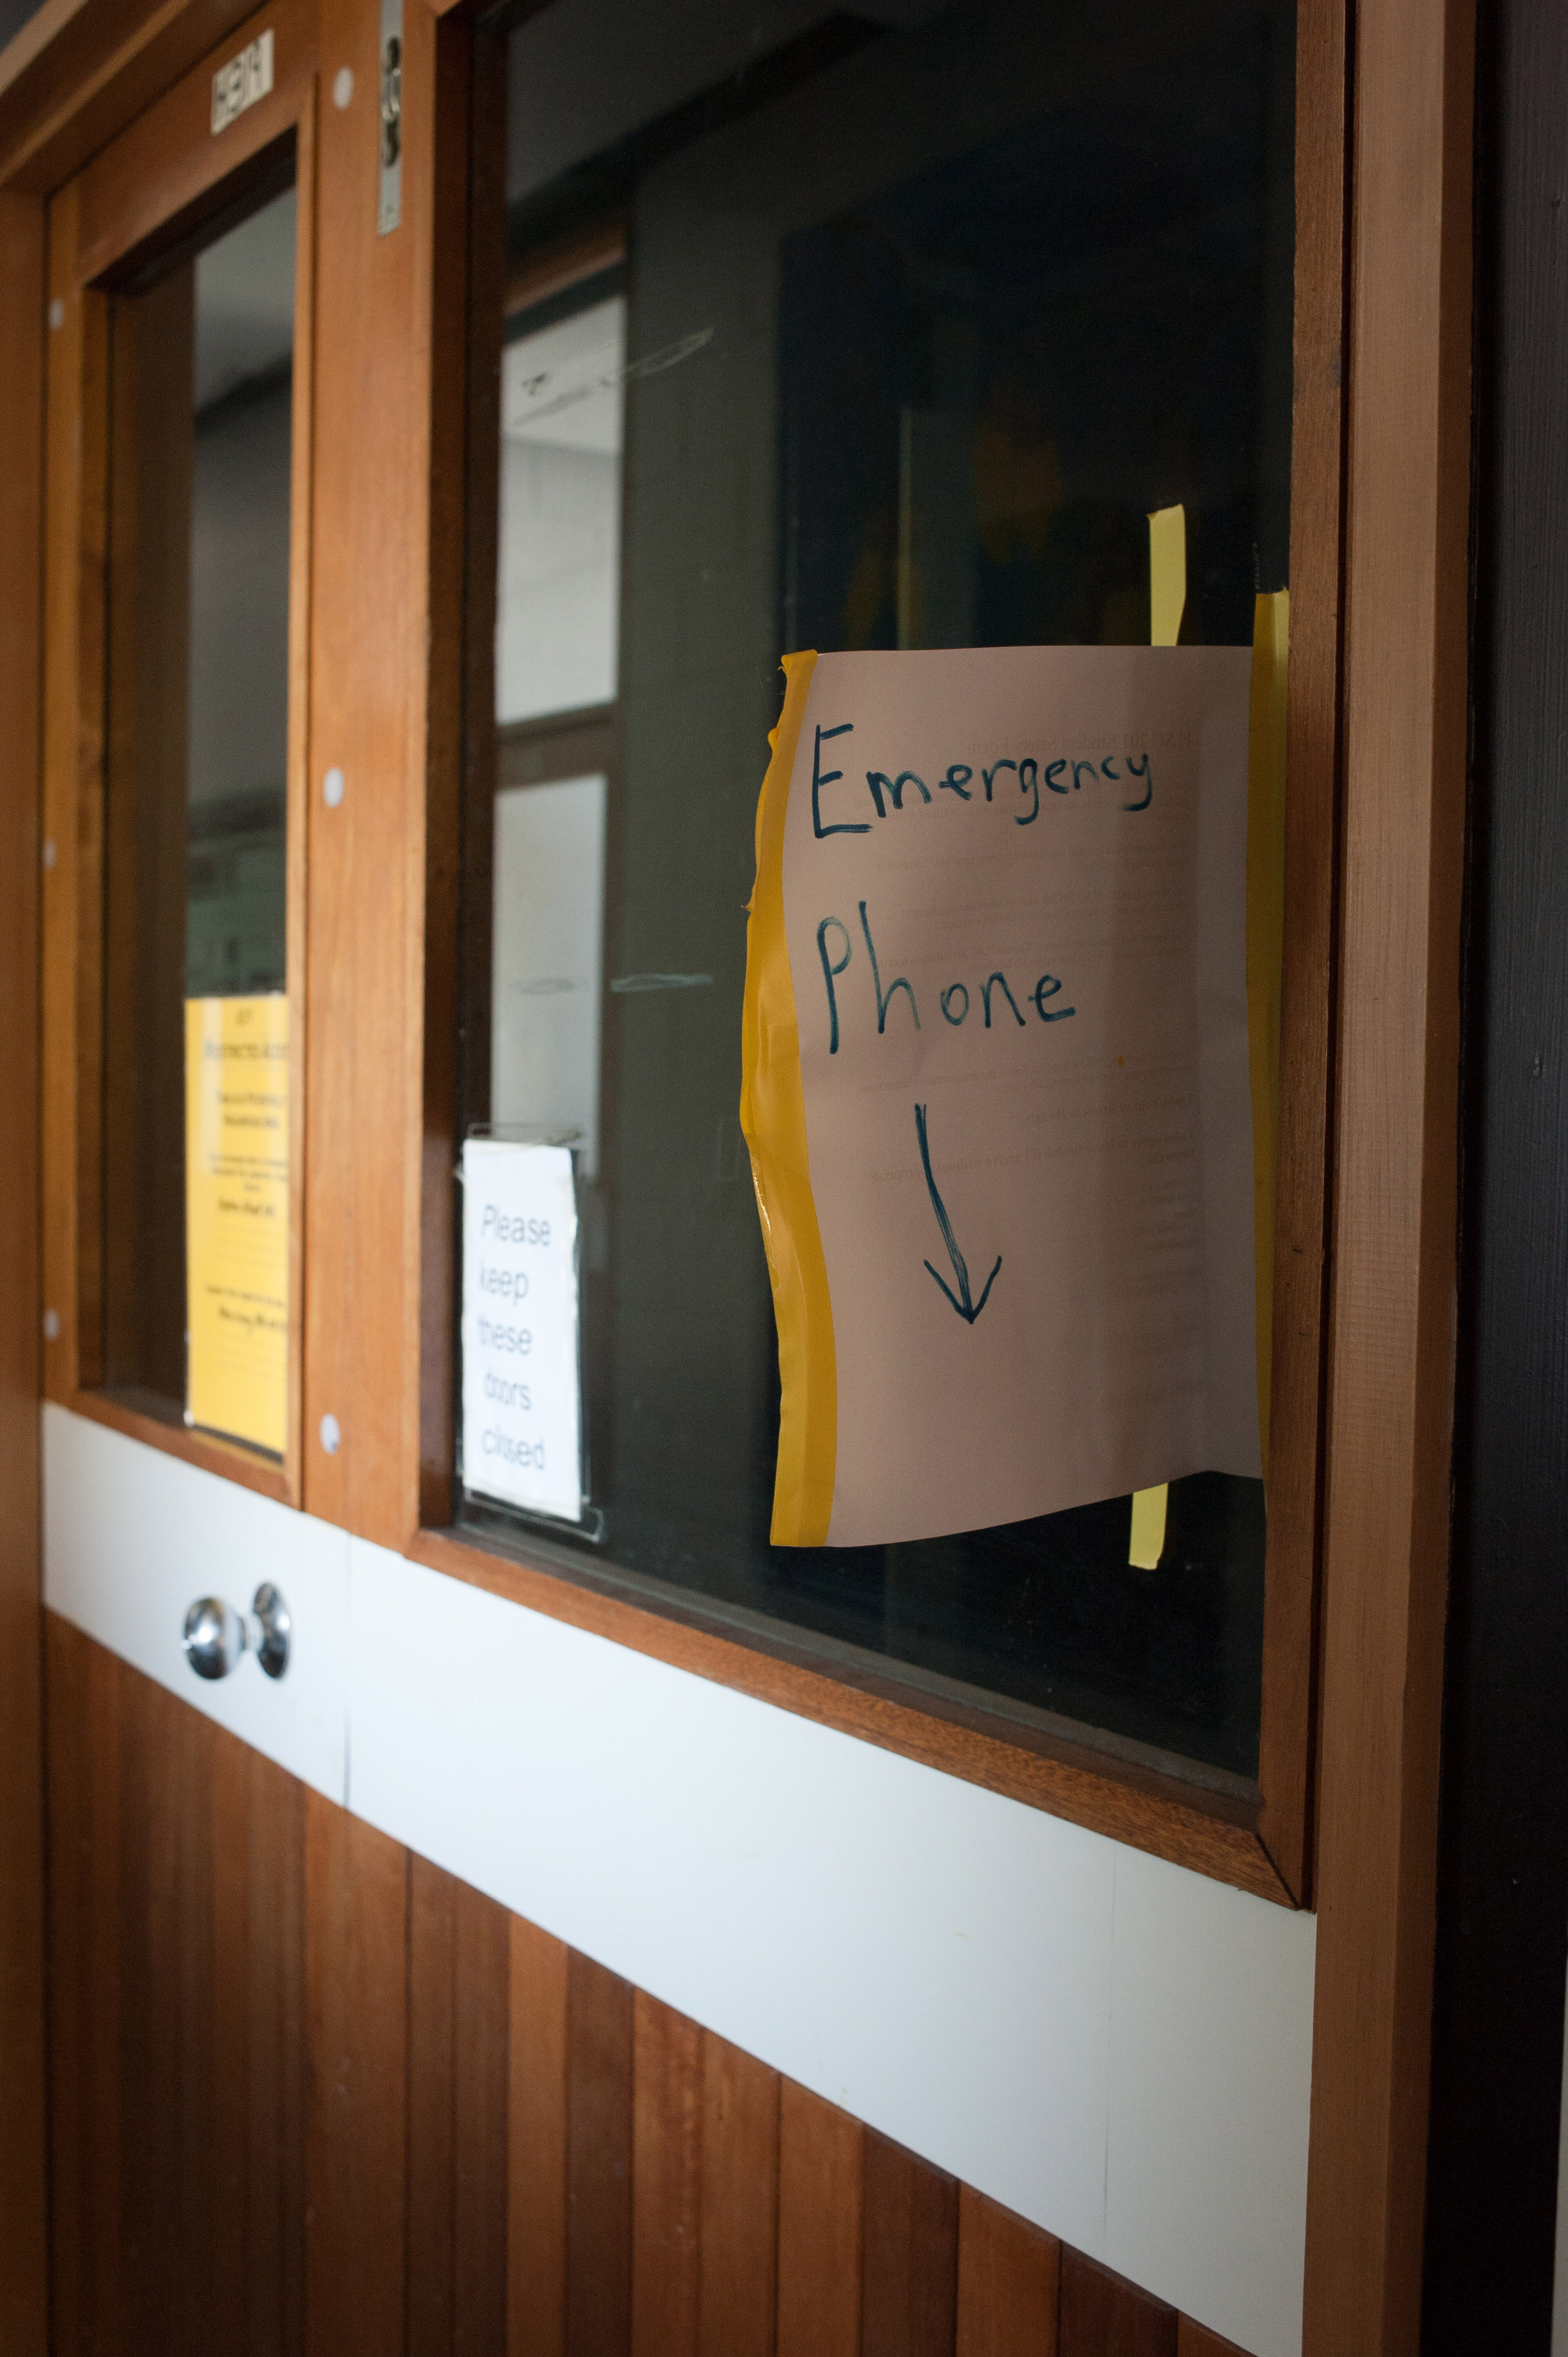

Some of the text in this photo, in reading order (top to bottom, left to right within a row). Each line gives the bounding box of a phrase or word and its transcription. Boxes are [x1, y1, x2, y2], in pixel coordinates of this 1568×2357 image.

[811, 723, 1153, 839] Emergency
[817, 901, 1076, 1054] Phone
[483, 1204, 550, 1246] Please
[479, 1261, 528, 1305] keep
[477, 1316, 532, 1354] these
[484, 1372, 532, 1410] doors
[481, 1425, 544, 1470] closed
